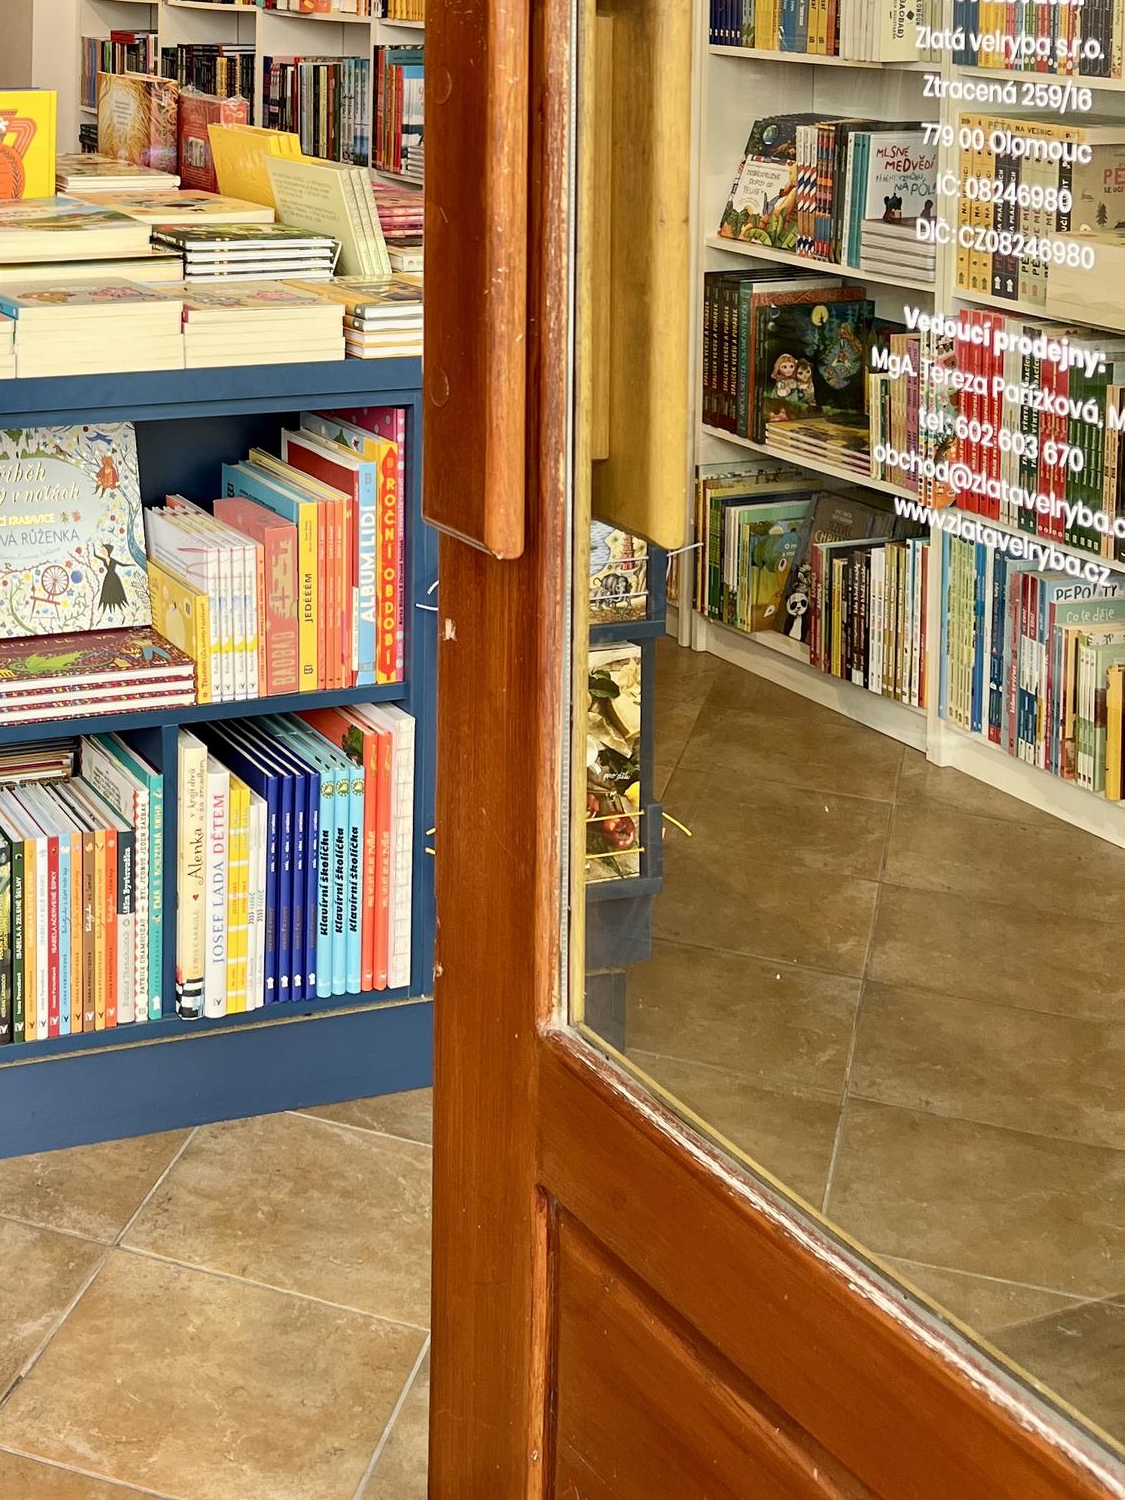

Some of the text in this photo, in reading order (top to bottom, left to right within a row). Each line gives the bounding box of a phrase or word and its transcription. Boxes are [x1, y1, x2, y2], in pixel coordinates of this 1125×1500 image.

[915, 26, 965, 50] Zlatá
[969, 30, 1050, 64] velryba
[923, 75, 1093, 114] Ztracená 259/16
[921, 124, 1093, 164] 779 00 Olomouc
[936, 171, 1073, 213] IČ: 08246980
[903, 305, 1106, 378] Vedoucí prodejny:
[921, 360, 988, 396] Tereza
[955, 417, 994, 448] 602
[998, 431, 1038, 459] 603
[1043, 440, 1084, 472] 670
[25, 482, 81, 503] notách
[22, 528, 81, 545] RŮŽENKA
[893, 497, 1111, 587] www.zlatavelryba.cz
[360, 548, 376, 623] ALBUM
[186, 827, 204, 886] Alenka
[210, 793, 225, 964] JOSEF LADA DĚTEM
[319, 829, 330, 936] Klavírní školíčka
[334, 827, 345, 933] Klavírní školíčka
[349, 826, 360, 933] Klavírní školíčka
